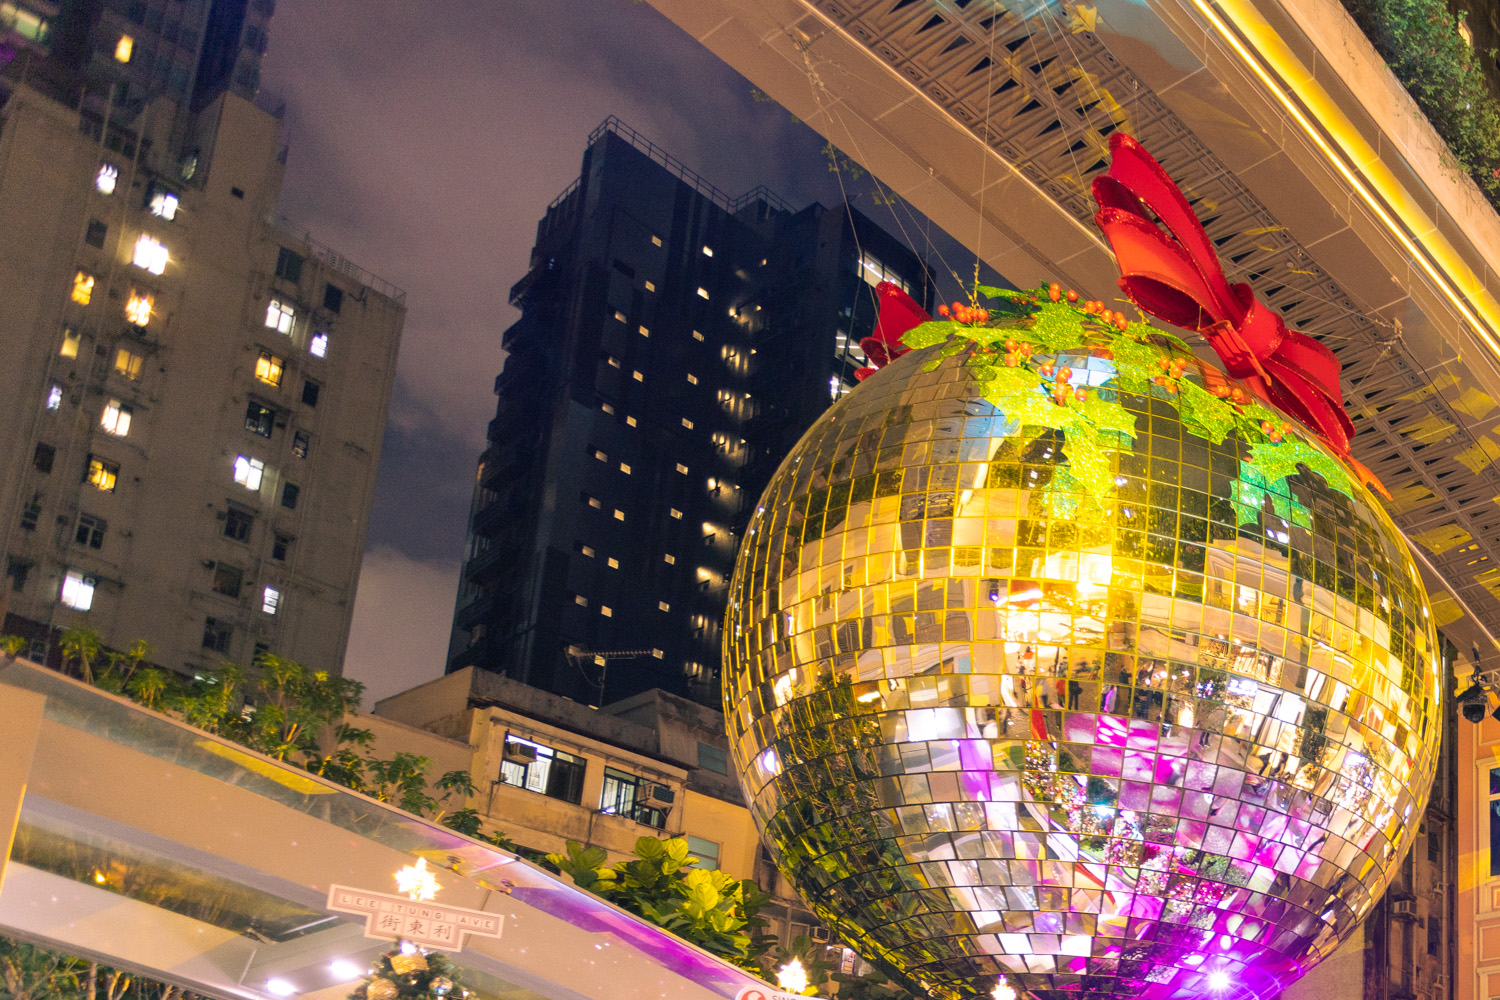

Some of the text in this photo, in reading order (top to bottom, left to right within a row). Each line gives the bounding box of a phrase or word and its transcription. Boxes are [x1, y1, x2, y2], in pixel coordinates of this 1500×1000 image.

[342, 895, 492, 928] LEE TUNG AVE
